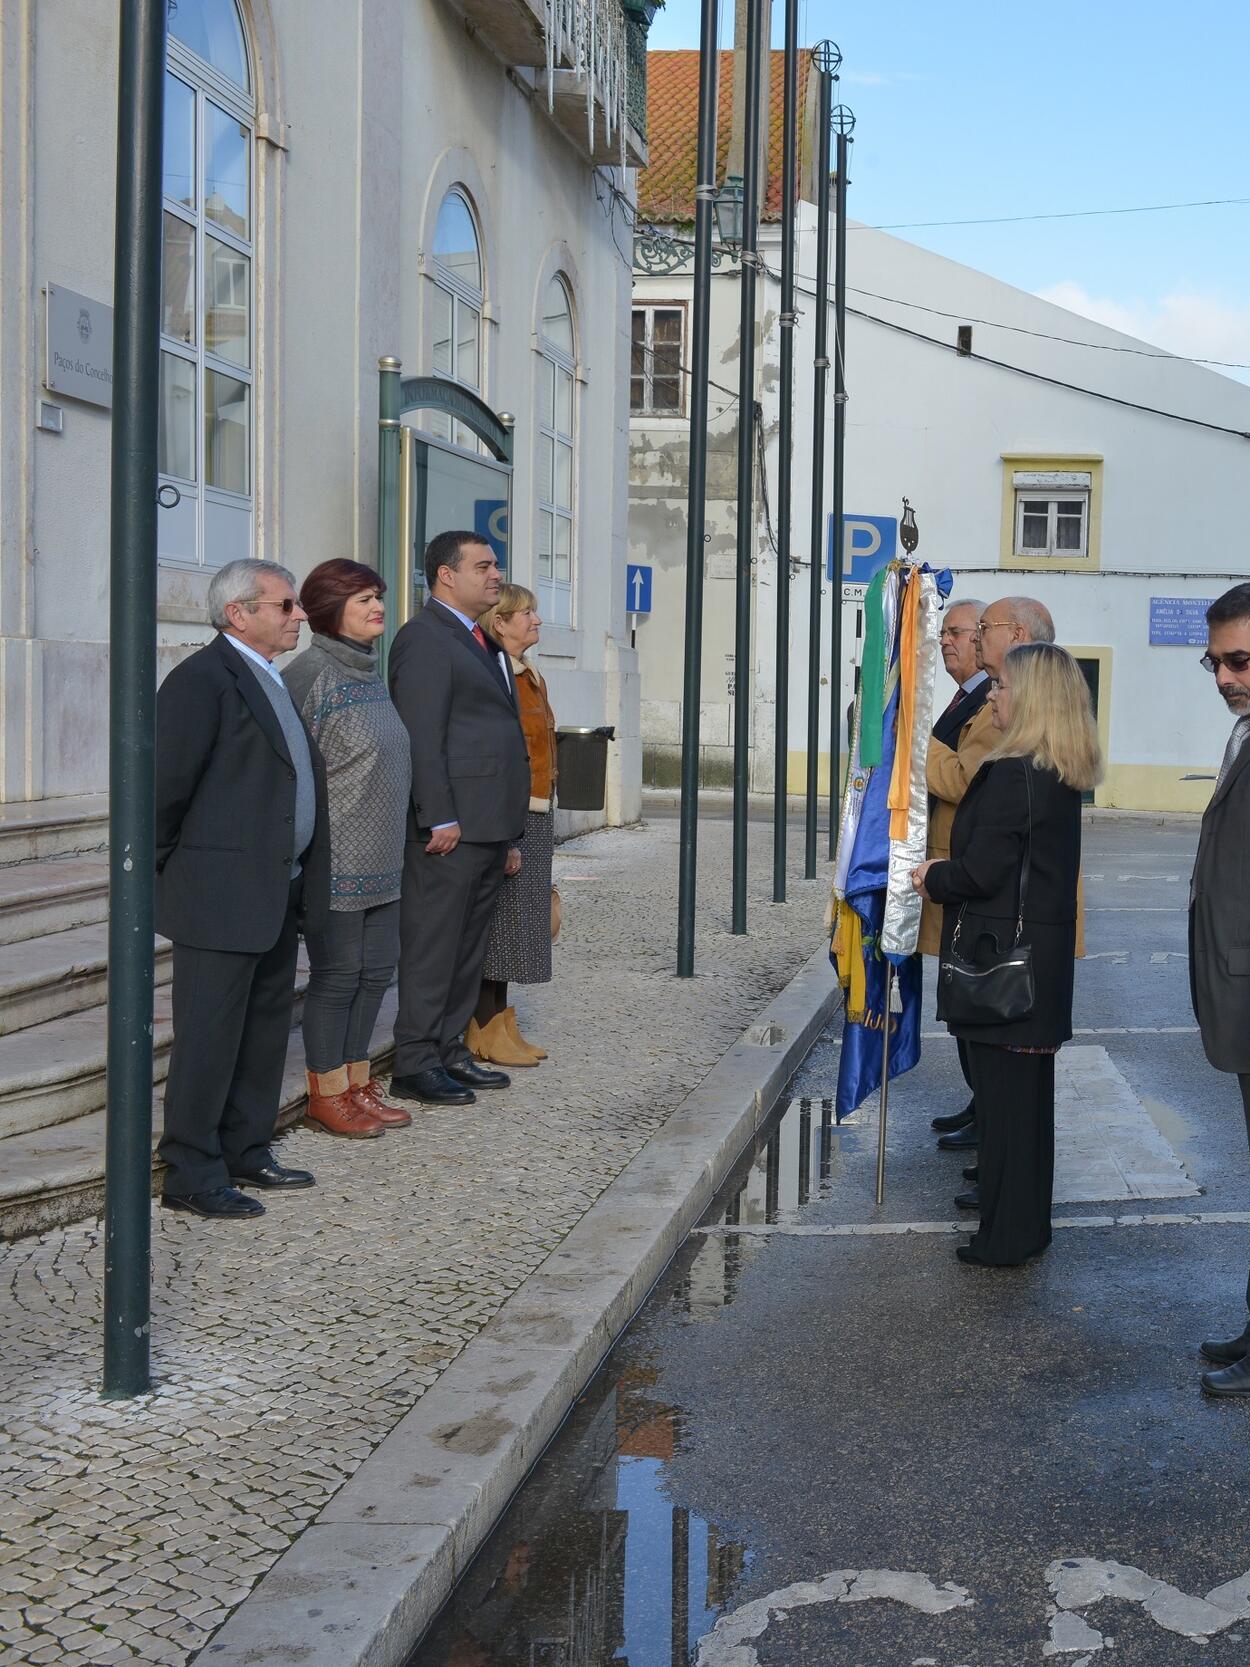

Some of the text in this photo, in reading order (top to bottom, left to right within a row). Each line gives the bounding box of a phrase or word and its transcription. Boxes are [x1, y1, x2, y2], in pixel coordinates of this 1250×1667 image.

[54, 352, 74, 373] Paços
[75, 359, 84, 375] do
[843, 521, 881, 575] P
